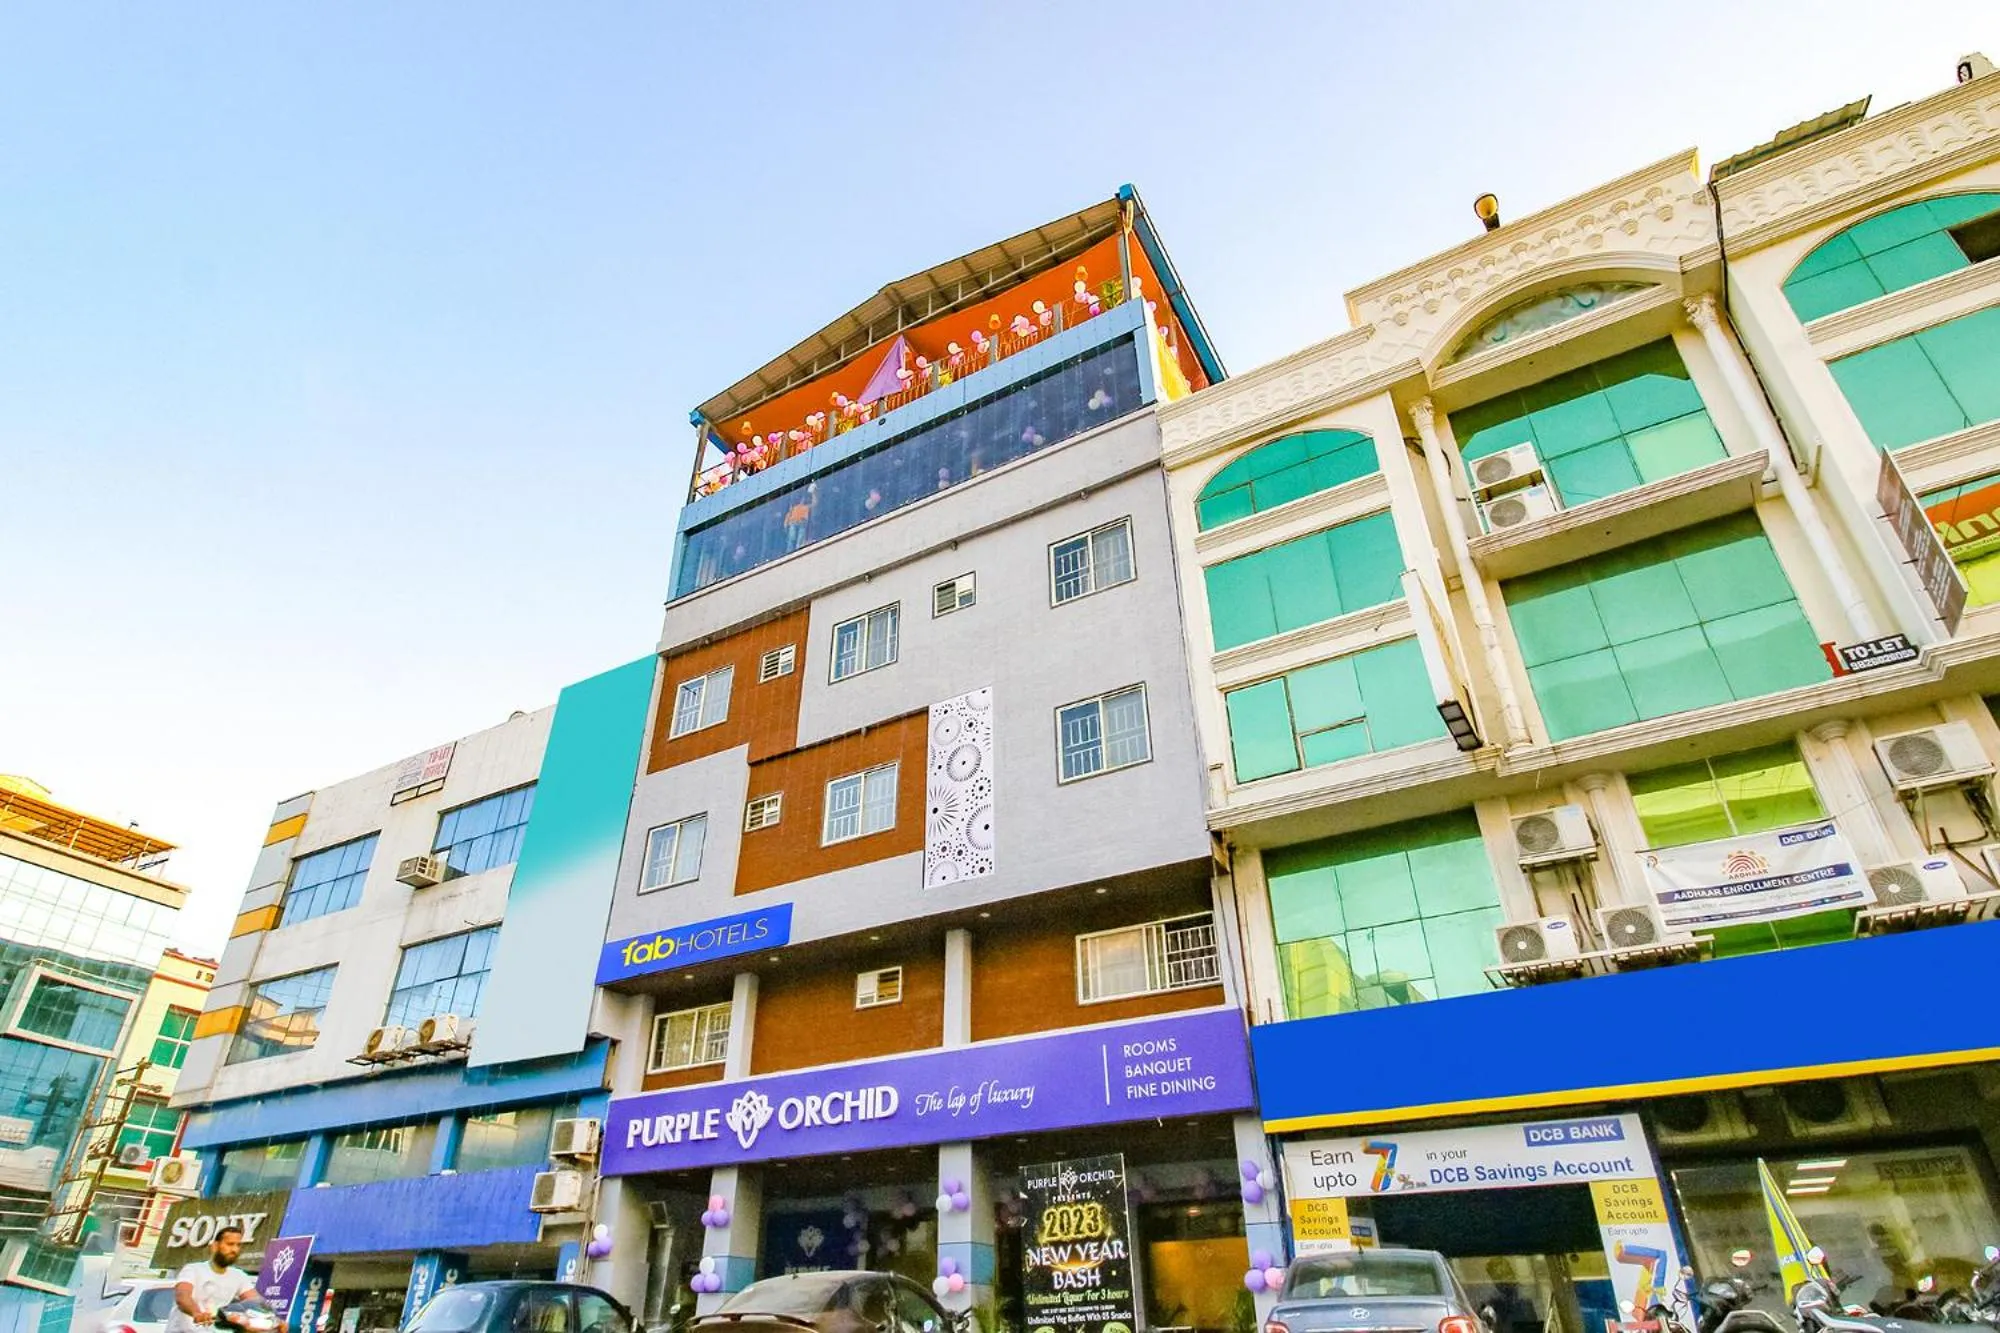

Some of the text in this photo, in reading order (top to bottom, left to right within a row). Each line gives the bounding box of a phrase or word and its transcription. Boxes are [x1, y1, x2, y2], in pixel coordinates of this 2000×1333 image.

[1844, 637, 1904, 660] TO-LET
[1673, 886, 1722, 901] AADHAAR
[1723, 877, 1792, 896] ENROLLMENT
[1793, 867, 1836, 884] CENTRE
[1123, 1038, 1177, 1058] ROOMS
[1124, 1057, 1192, 1078] BANQUET
[1126, 1075, 1216, 1100] FINE DINING
[915, 1080, 1036, 1117] The lap of luxury
[626, 1085, 898, 1149] PURPLE ORCHID
[1530, 1123, 1617, 1142] DCB BANK
[1310, 1149, 1354, 1166] Earn
[1426, 1150, 1467, 1162] in your
[1027, 1169, 1115, 1190] PURPLE ORCHID
[1430, 1156, 1634, 1185] DCB Savings Account
[1313, 1172, 1357, 1191] upto
[1612, 1184, 1639, 1194] DCB
[1604, 1197, 1653, 1208] Savings
[1043, 1202, 1101, 1239] 2023
[1300, 1216, 1340, 1226] Savings
[1607, 1209, 1659, 1220] Account
[1300, 1227, 1342, 1236] Account
[1608, 1228, 1626, 1236] Earn
[1027, 1240, 1127, 1267] NEW YEAR
[1052, 1267, 1101, 1290] BASH
